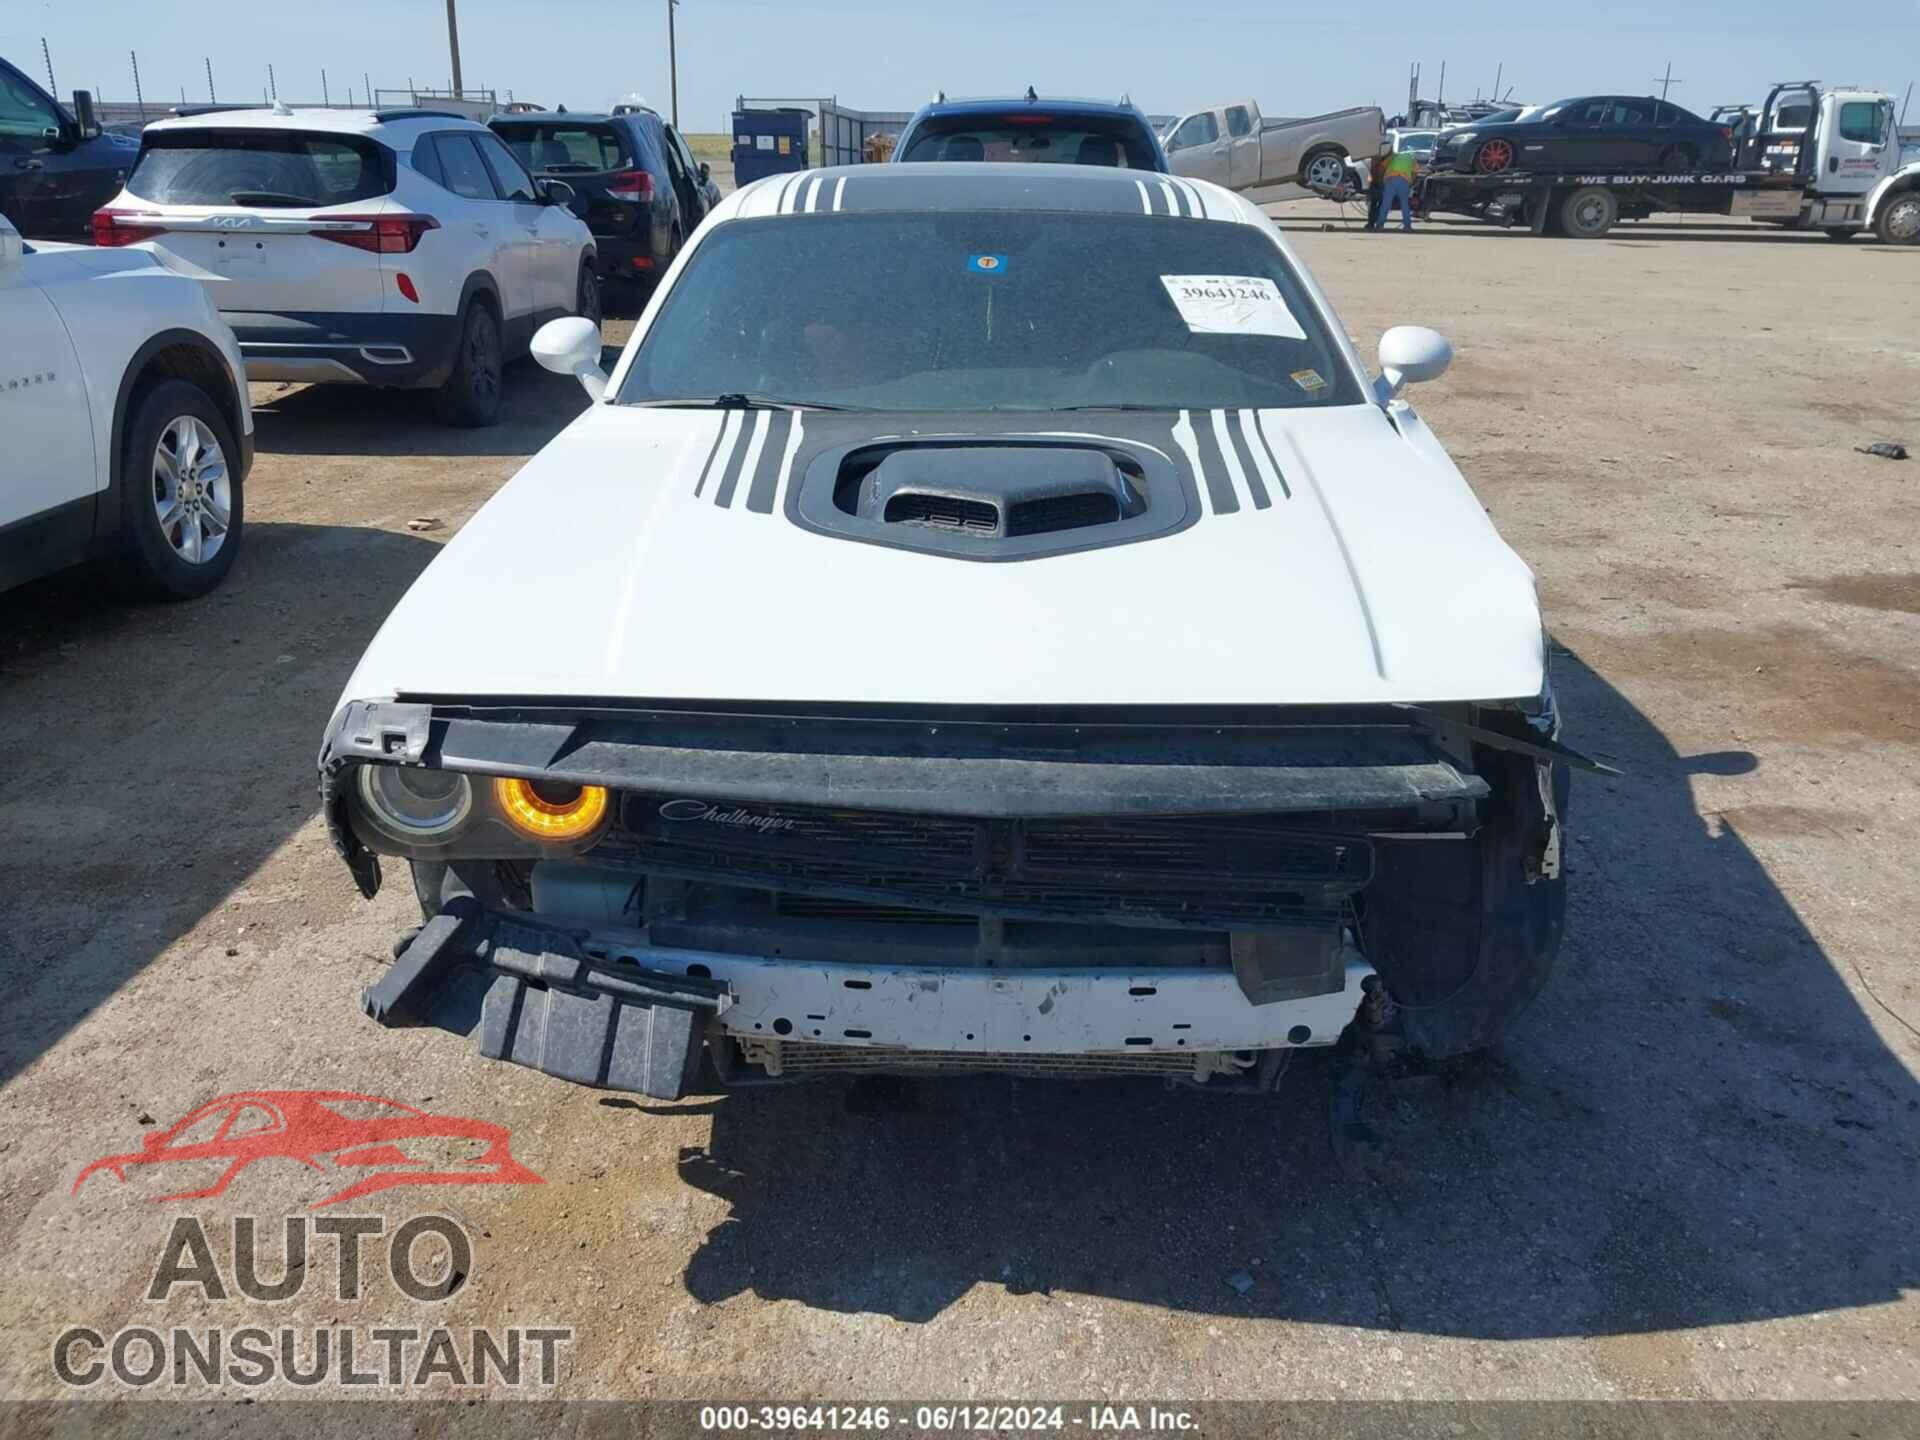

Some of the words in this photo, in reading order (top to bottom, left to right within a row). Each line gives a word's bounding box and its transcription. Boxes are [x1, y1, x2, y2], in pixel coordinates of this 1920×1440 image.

[1581, 175, 1607, 184] WE
[1612, 175, 1646, 184] BUY
[1651, 175, 1695, 184] JUNK
[1700, 174, 1746, 184] CARS
[1180, 287, 1271, 301] 39641246
[658, 799, 796, 833] Challenger
